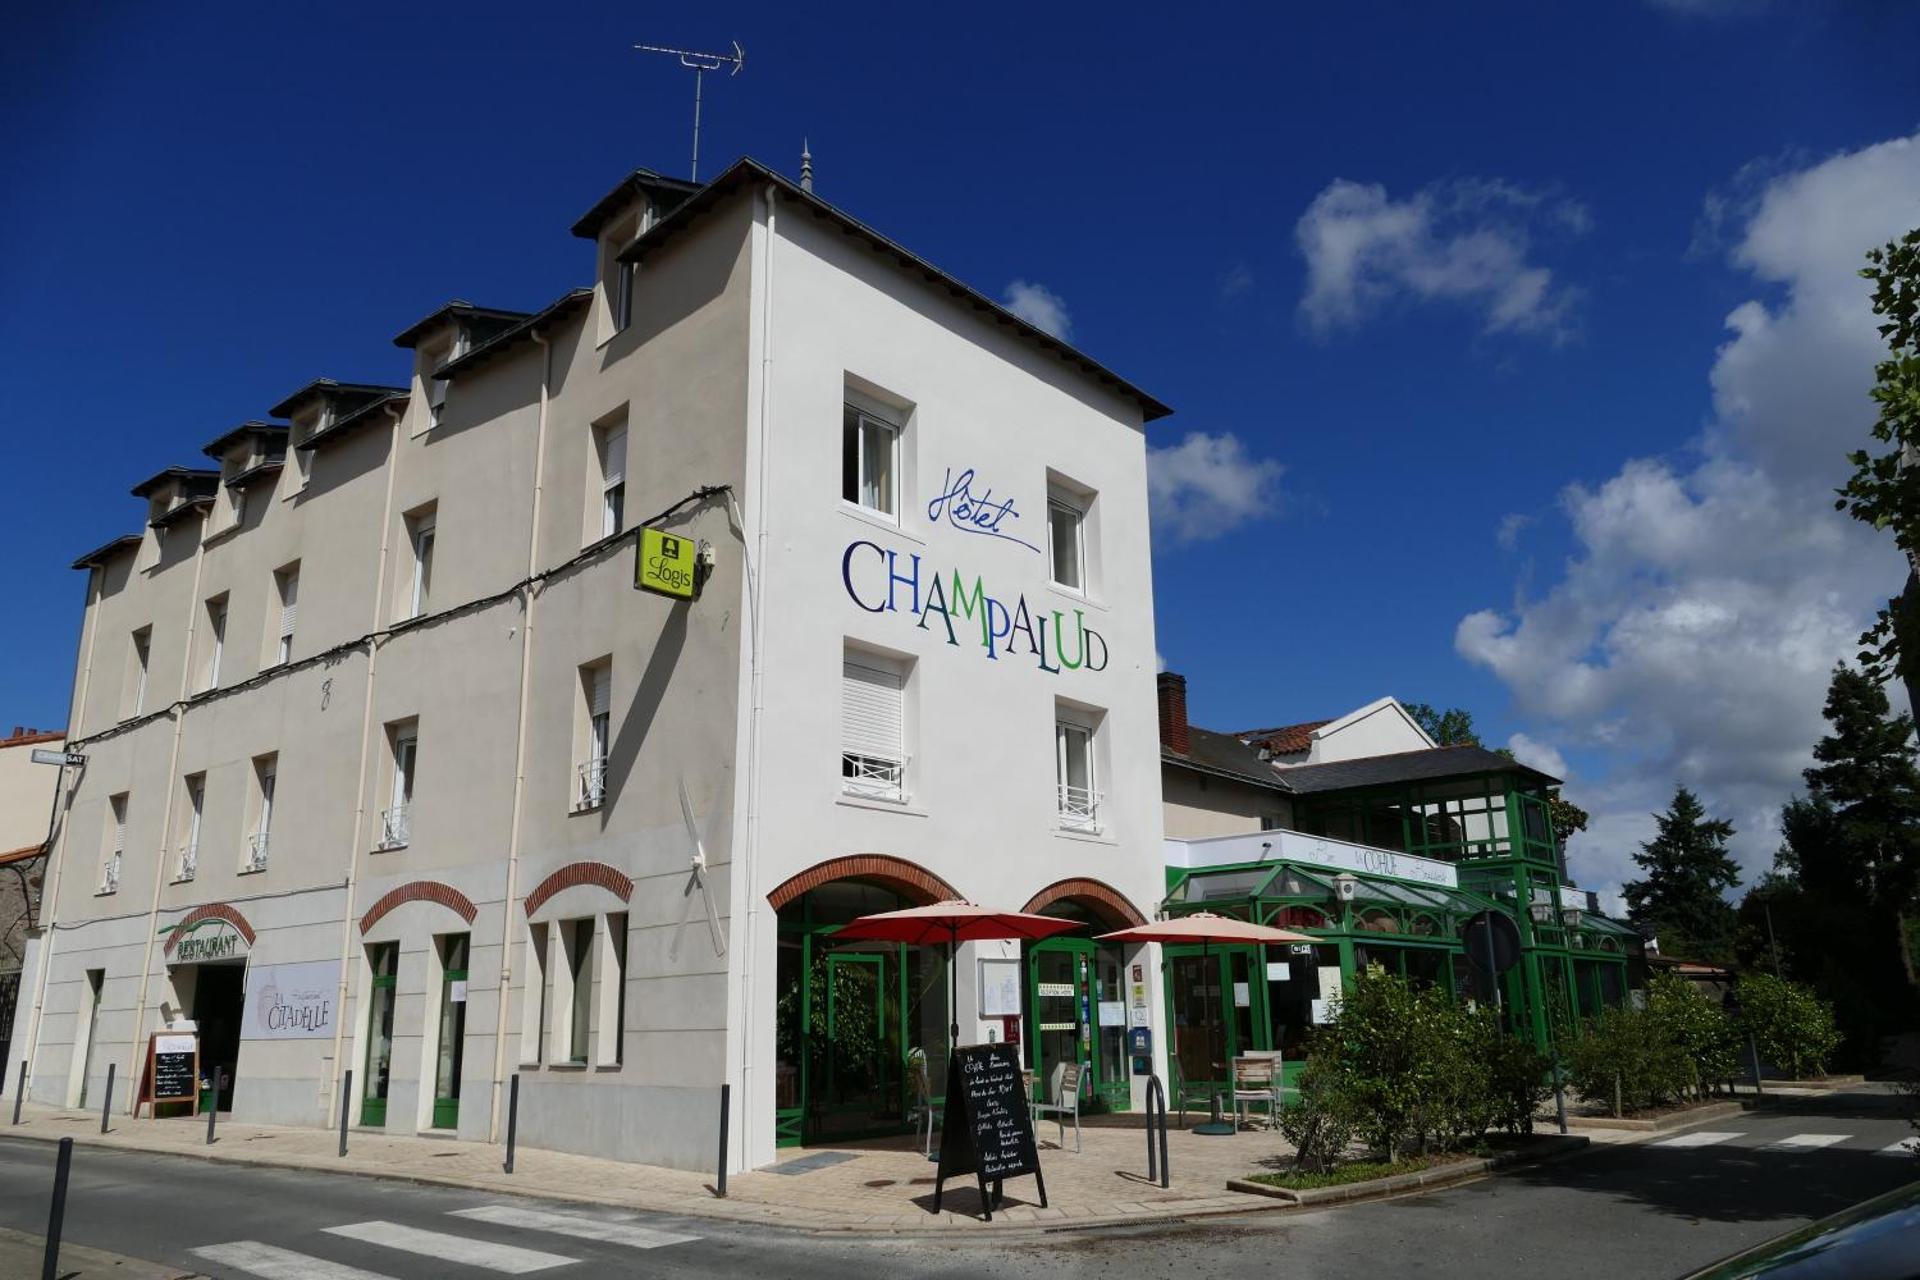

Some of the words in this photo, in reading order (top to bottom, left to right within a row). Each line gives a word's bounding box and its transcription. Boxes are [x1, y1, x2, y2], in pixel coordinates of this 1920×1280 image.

[928, 467, 1041, 553] Hôtel
[646, 556, 691, 589] Logis
[842, 540, 1108, 674] CHAMPALUD
[1363, 850, 1400, 876] COHUE
[178, 935, 238, 960] RESTAURANT
[268, 1000, 330, 1032] CITADELLE
